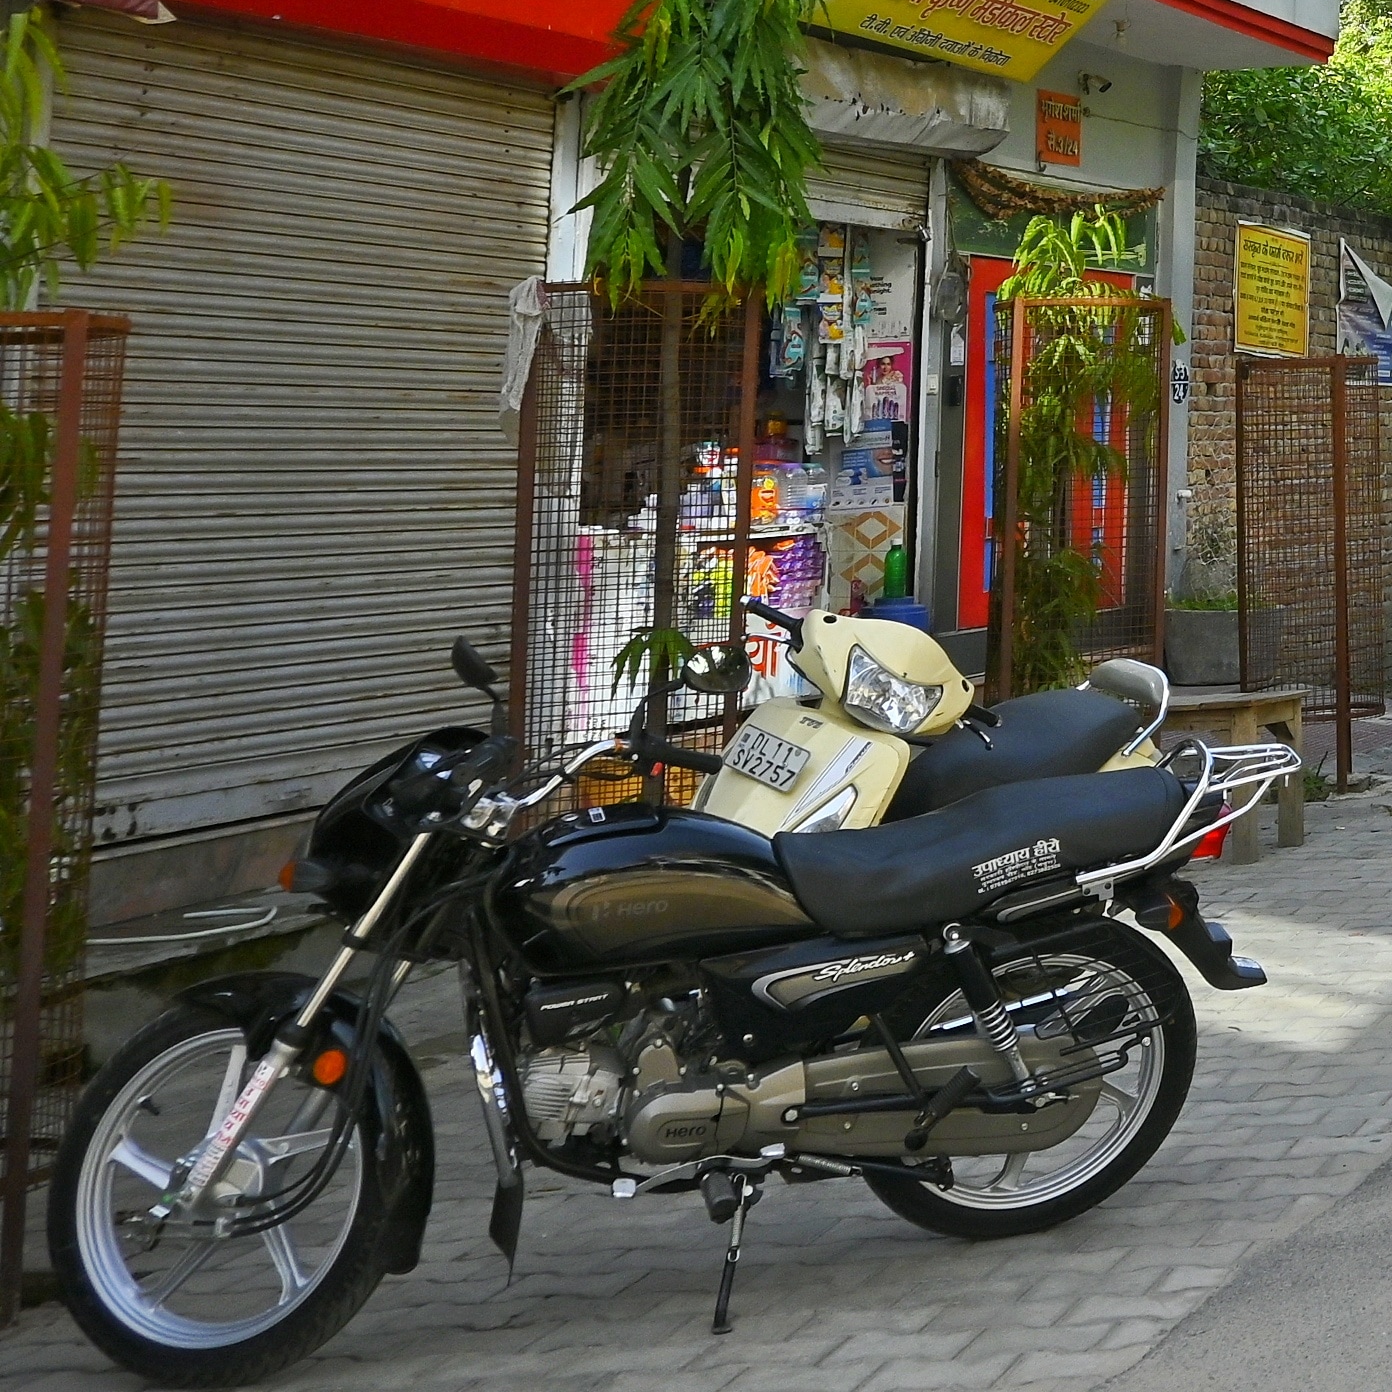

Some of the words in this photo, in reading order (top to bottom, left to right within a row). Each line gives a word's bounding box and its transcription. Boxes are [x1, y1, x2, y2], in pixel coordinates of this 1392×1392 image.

[1026, 10, 1074, 46] स्टोर
[967, 44, 983, 58] के
[751, 733, 770, 757] DL
[732, 748, 797, 787] SV2757
[971, 847, 1031, 878] उपाध्याय
[1032, 838, 1061, 857] हीरो
[618, 900, 669, 916] Hero
[540, 1000, 576, 1011] POWER
[576, 993, 609, 1006] START
[665, 1126, 708, 1138] Hero
